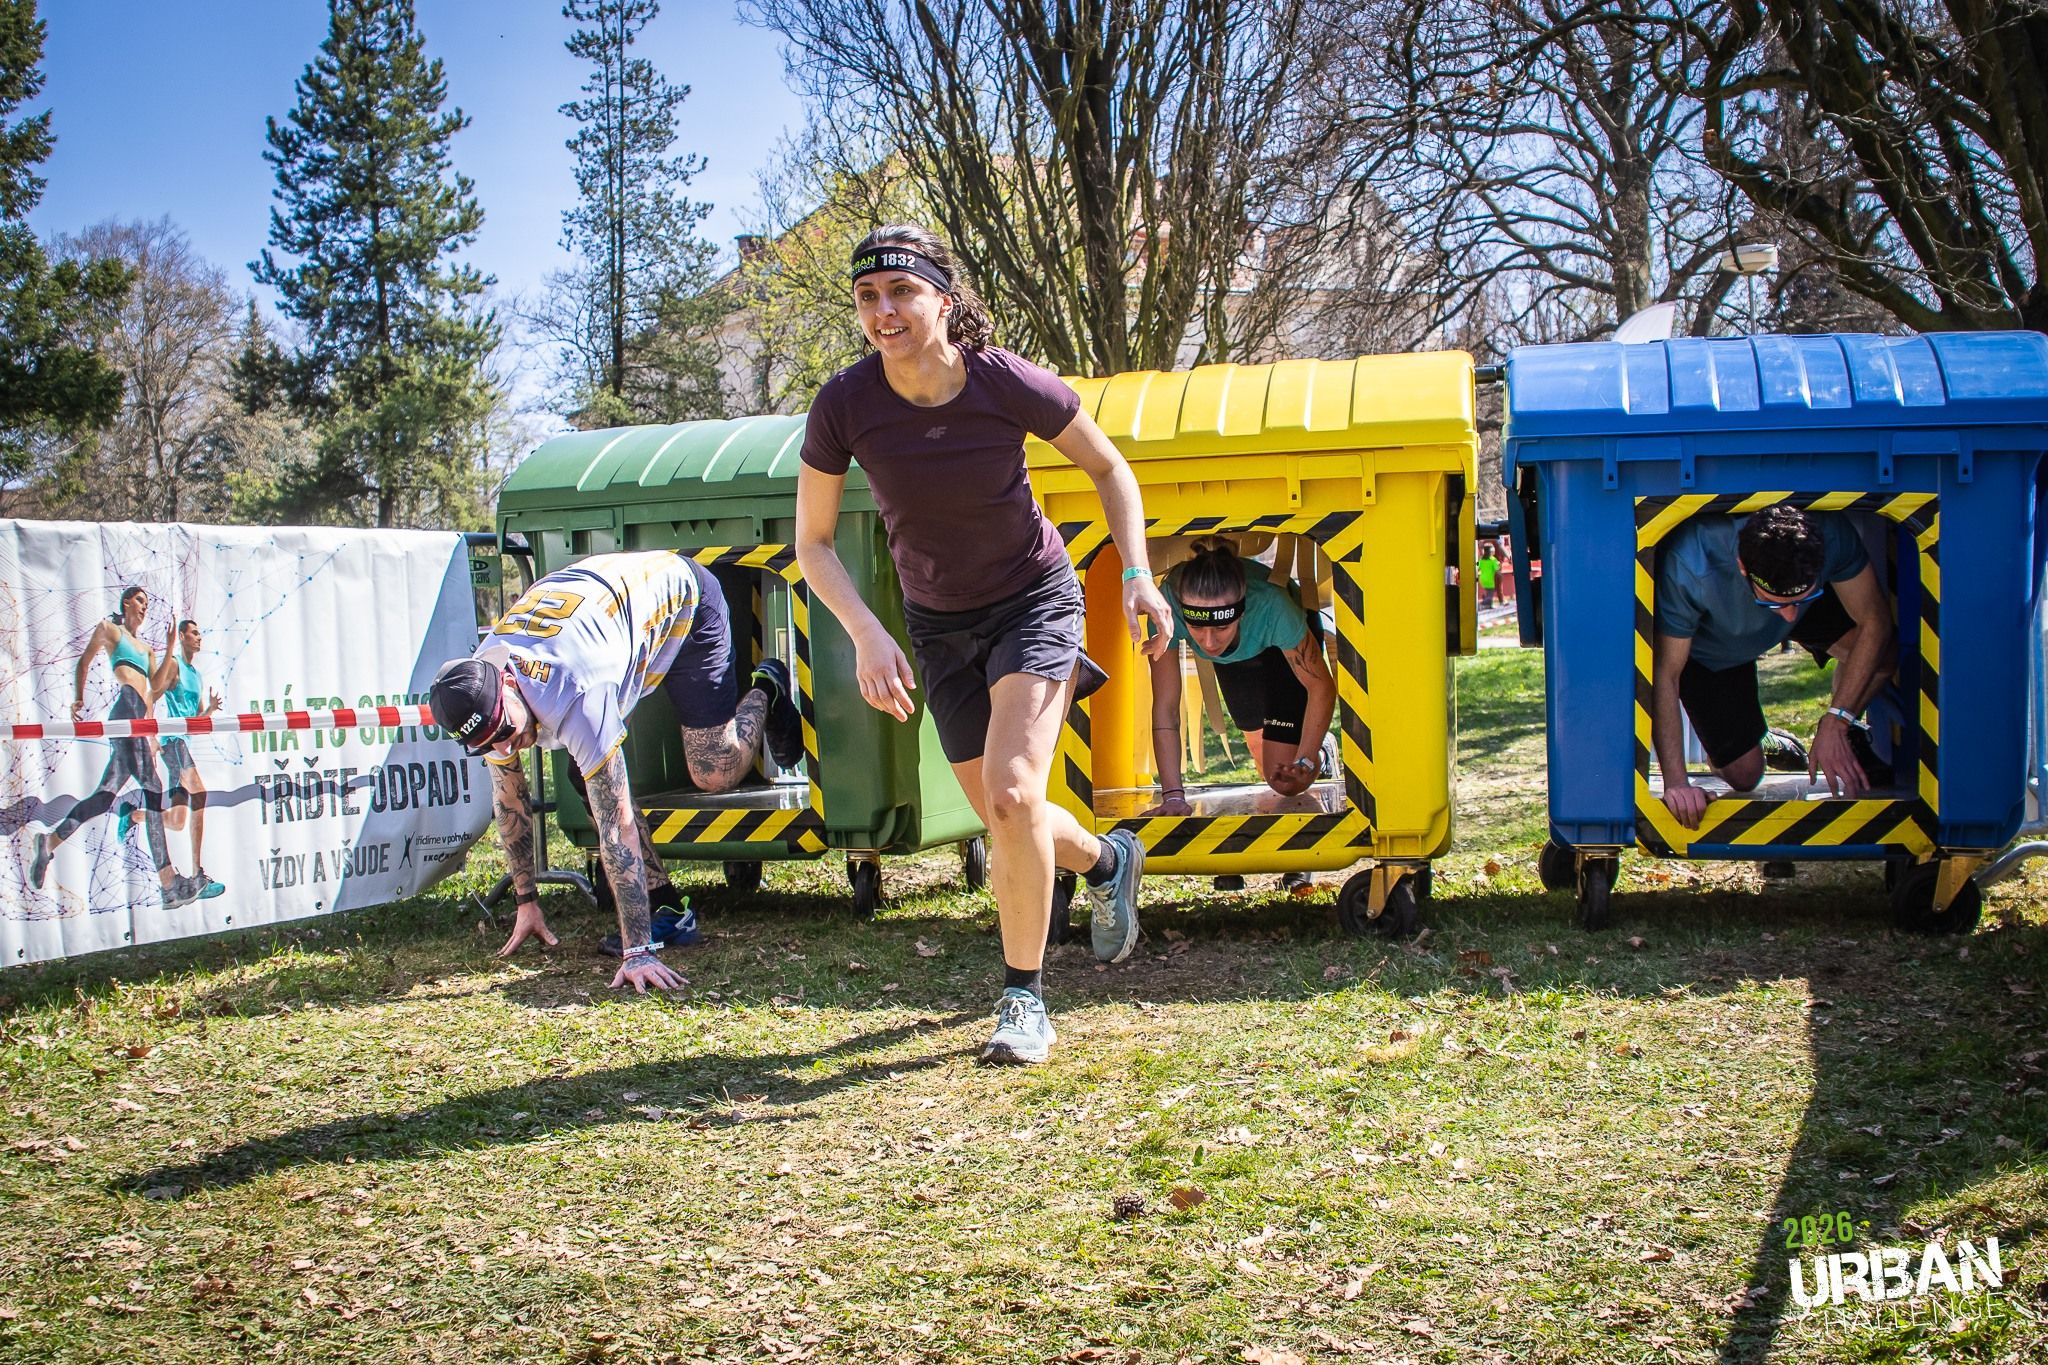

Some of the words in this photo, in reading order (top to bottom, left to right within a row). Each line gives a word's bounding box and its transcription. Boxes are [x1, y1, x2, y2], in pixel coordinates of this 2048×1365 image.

[852, 255, 876, 273] BAN
[881, 253, 916, 268] 1832
[925, 426, 947, 439] 4F
[493, 590, 586, 639] 22
[1212, 608, 1235, 620] 1069
[250, 684, 299, 753] MÁ
[306, 696, 346, 749] TO
[460, 712, 482, 735] 1225
[254, 756, 360, 825] TŘIĎTE
[369, 758, 471, 814] ODPAD!
[448, 832, 472, 845] pohybu
[258, 848, 305, 890] VŽDY
[312, 852, 326, 883] A
[332, 839, 391, 880] VŠUDE
